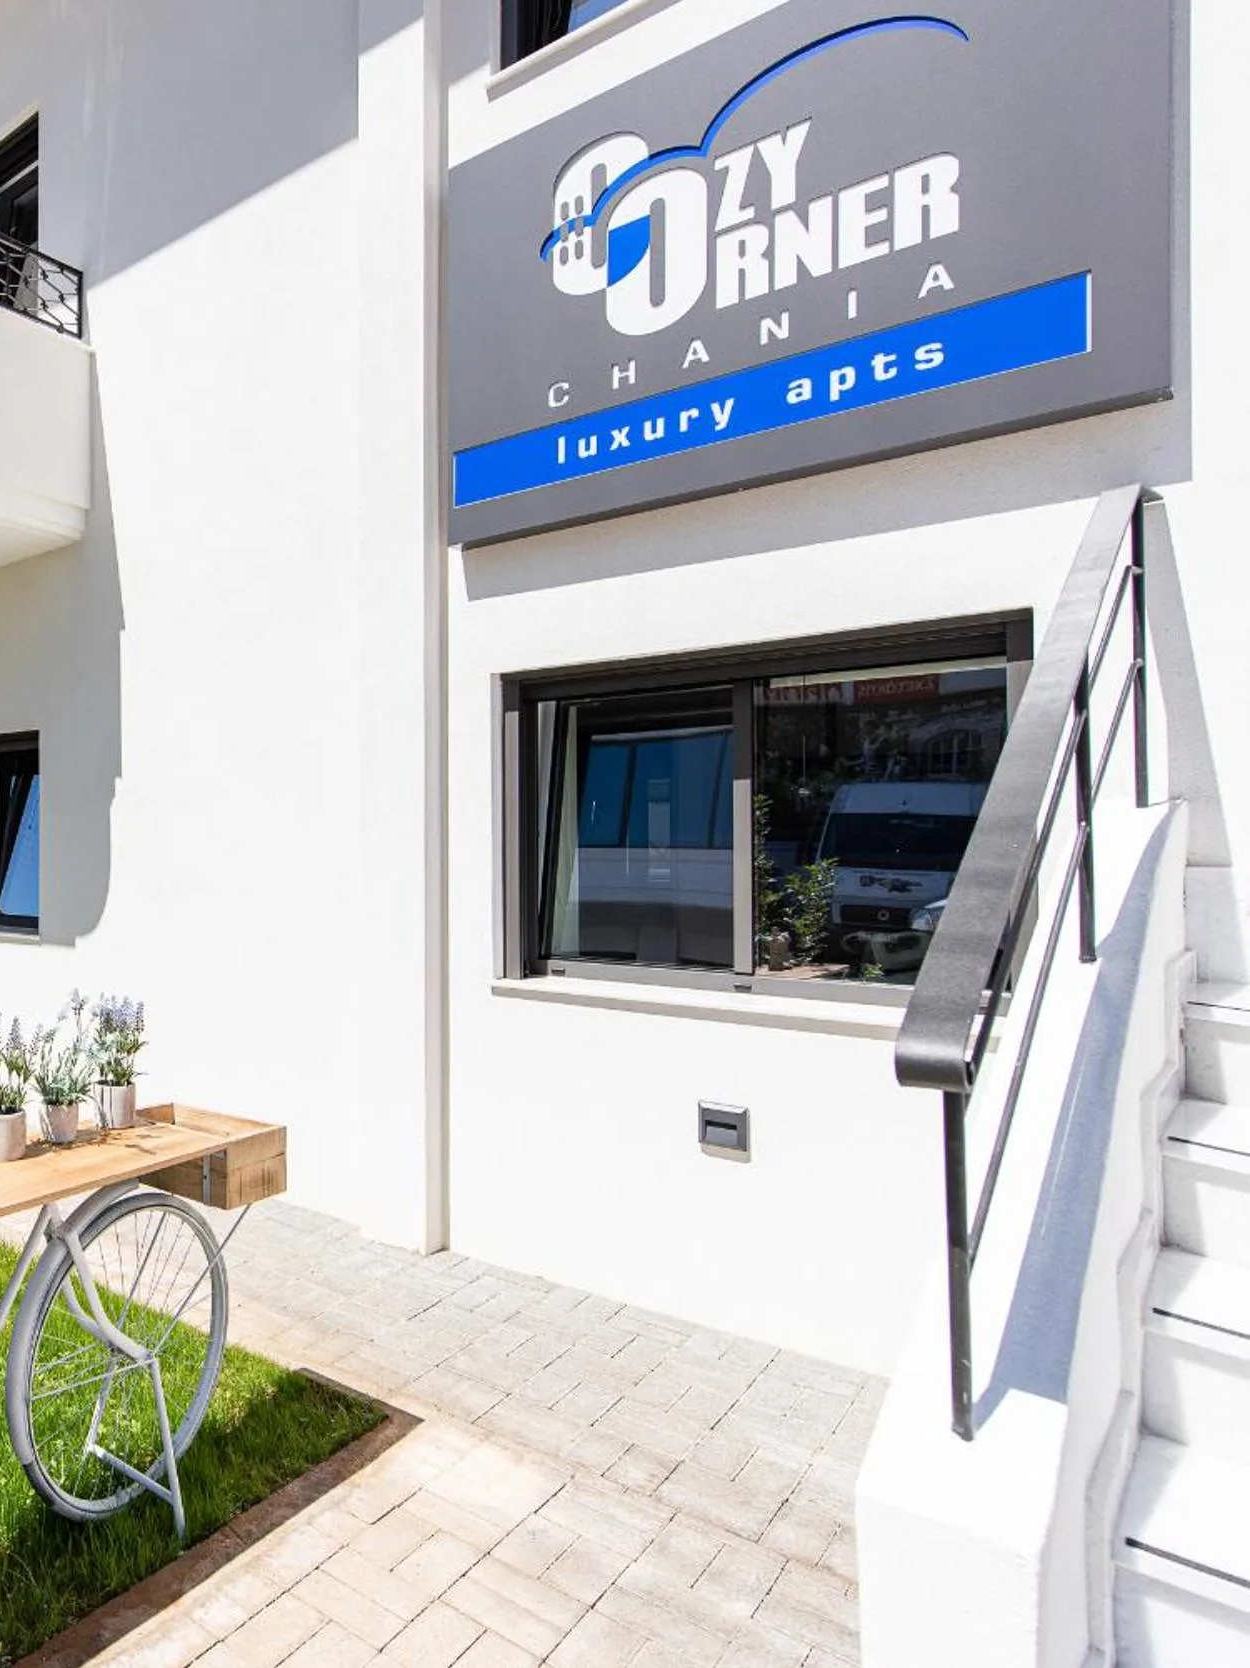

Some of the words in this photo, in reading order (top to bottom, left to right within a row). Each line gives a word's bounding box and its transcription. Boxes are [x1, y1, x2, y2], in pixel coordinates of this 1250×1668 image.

[547, 264, 955, 408] CHANIA
[557, 398, 735, 463] luxury
[786, 341, 945, 403] apts
